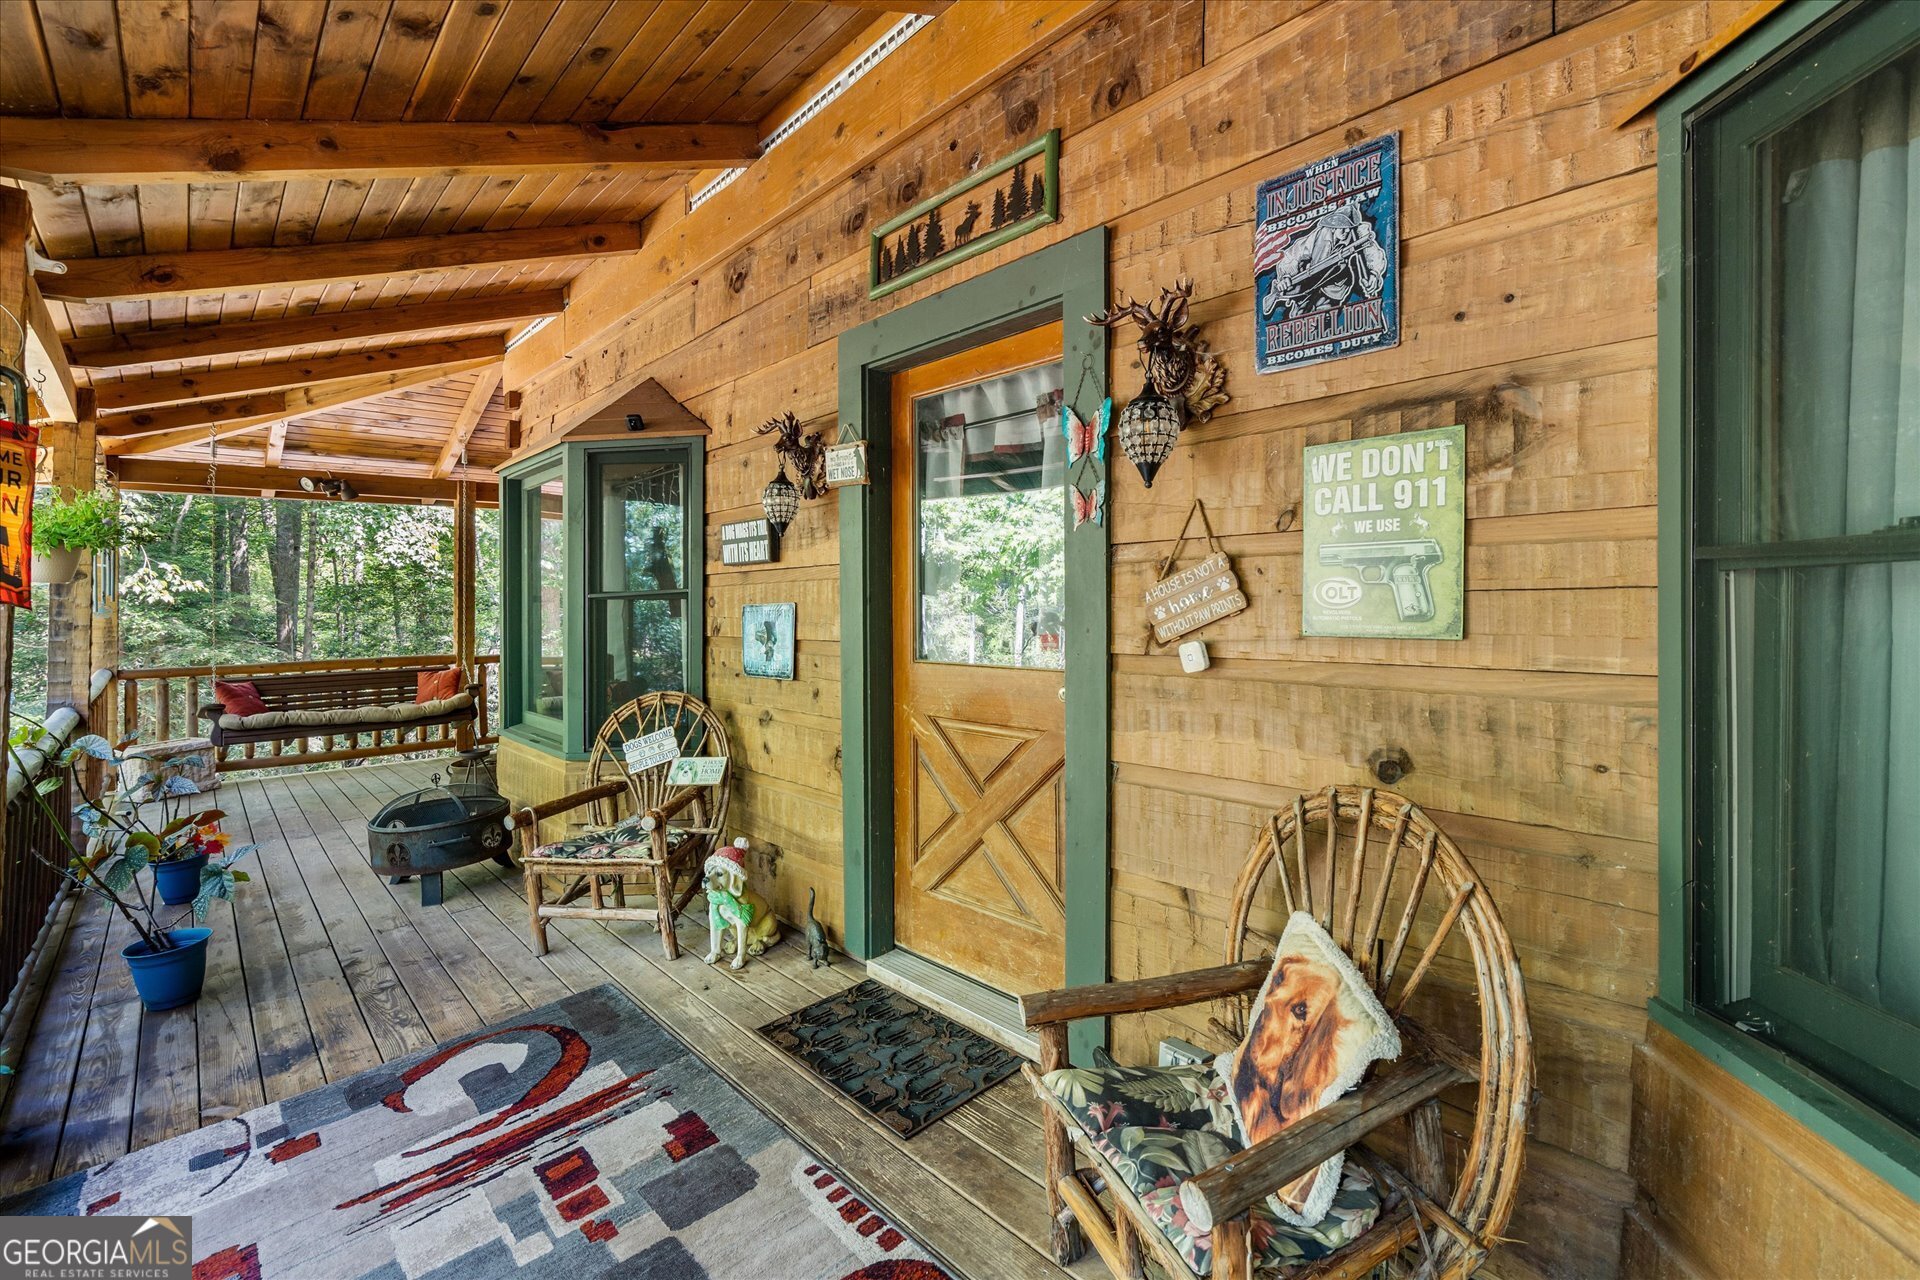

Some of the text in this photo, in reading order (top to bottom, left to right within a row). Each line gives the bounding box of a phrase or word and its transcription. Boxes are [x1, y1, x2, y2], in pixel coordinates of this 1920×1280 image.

[1305, 157, 1339, 178] WHEN
[1266, 152, 1382, 220] INJUSTICE
[1267, 186, 1381, 234] BECOMES LAW
[1266, 298, 1382, 354] REBELLION
[1266, 332, 1381, 365] BECOMES DUTY
[828, 468, 839, 480] WET
[1311, 439, 1452, 484] WE DON'T
[1314, 476, 1447, 516] CALL 911
[1354, 517, 1400, 534] WE USE
[722, 539, 768, 564] WITH ITS HEART
[1145, 557, 1225, 603] A HOUSE IS NOT A
[1157, 593, 1242, 639] WITHOUT PAW PRINTS
[624, 728, 673, 752] DOGS WELCOME
[630, 748, 679, 772] PEOPLE TOLERATED
